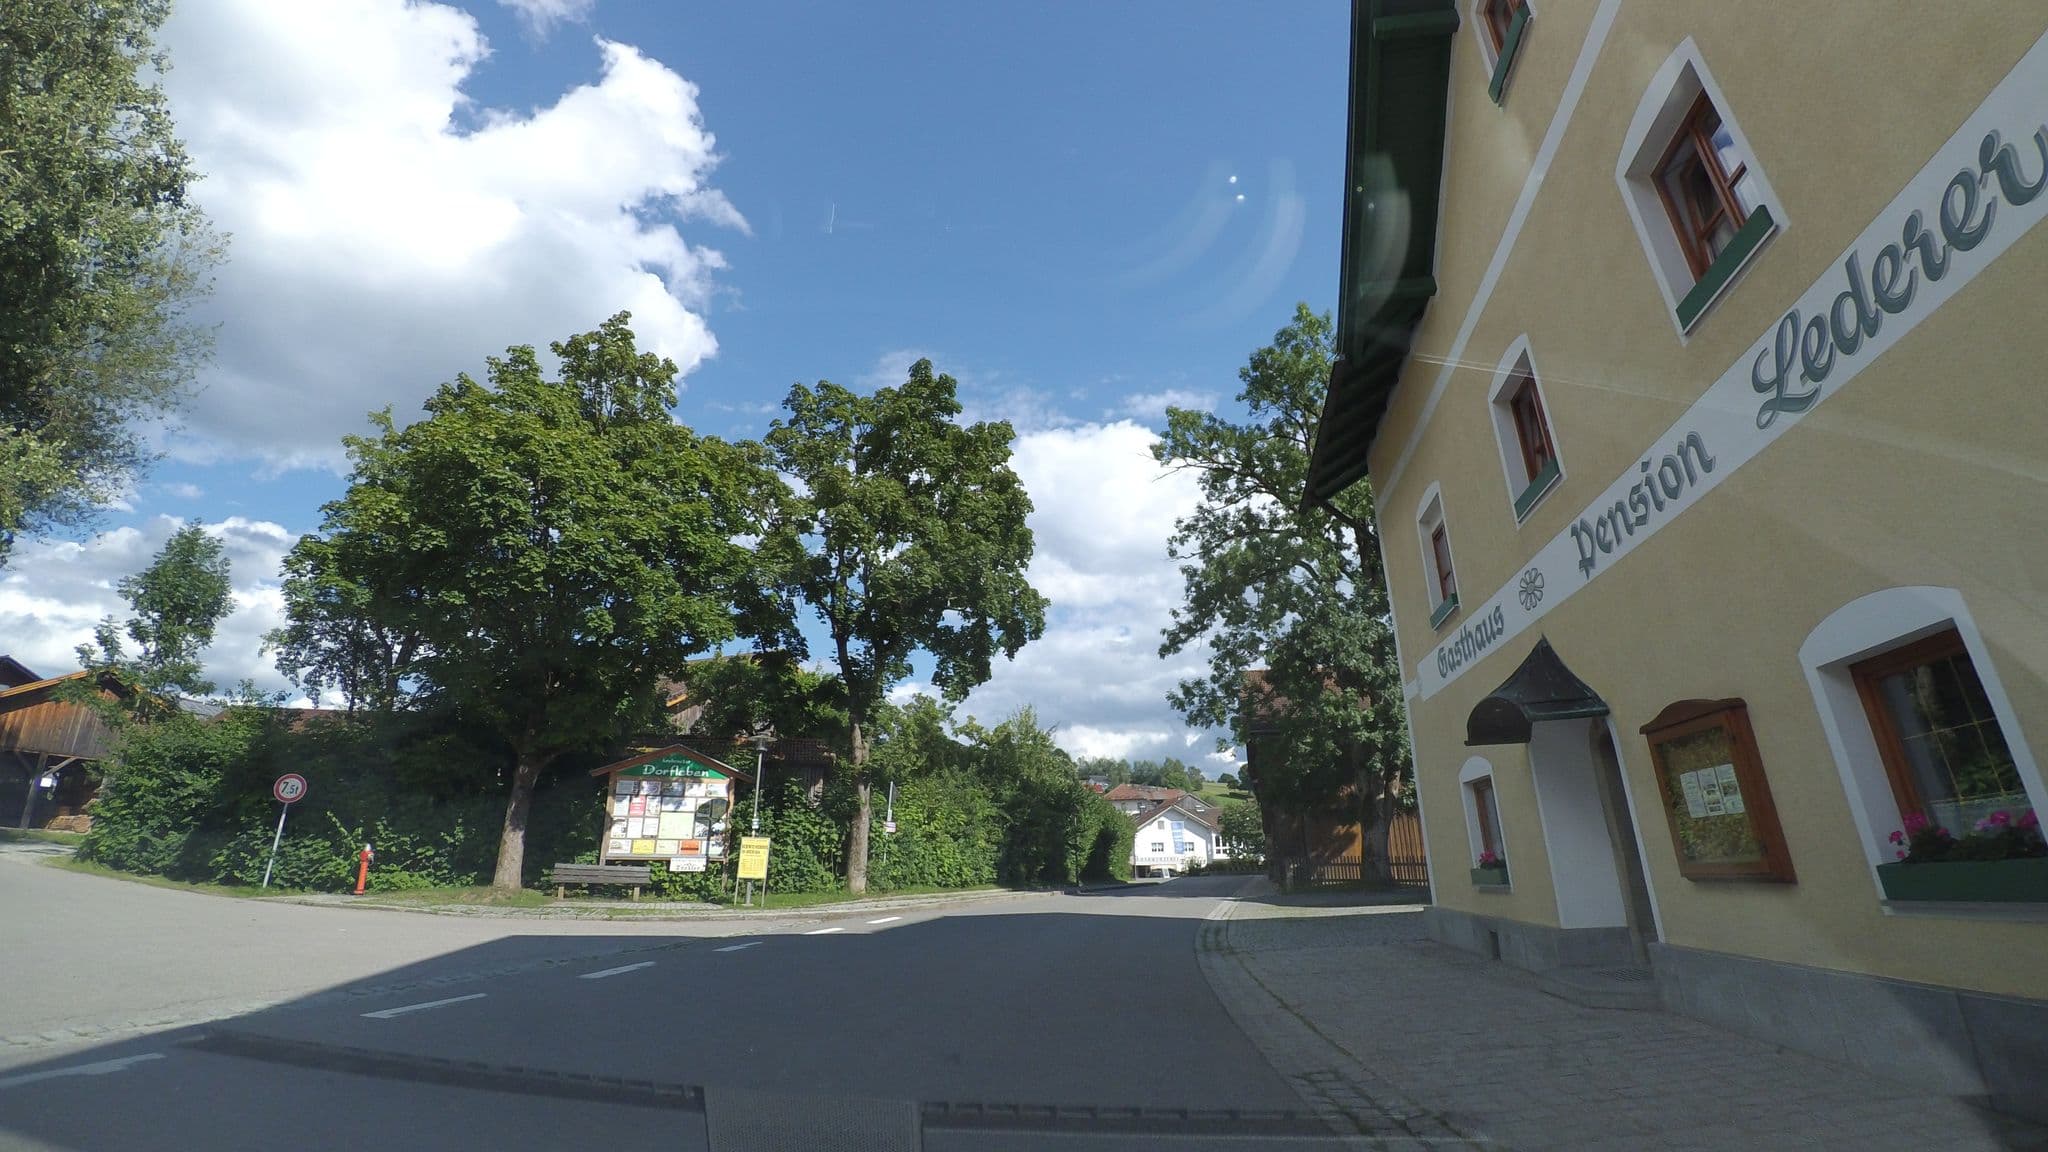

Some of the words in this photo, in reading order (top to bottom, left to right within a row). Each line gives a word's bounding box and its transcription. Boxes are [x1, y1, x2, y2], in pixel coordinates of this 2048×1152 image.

[1438, 601, 1504, 678] Gasthaus
[1571, 431, 1716, 580] Pension
[1752, 124, 2048, 429] Lederer
[642, 764, 709, 777] Dorfleben
